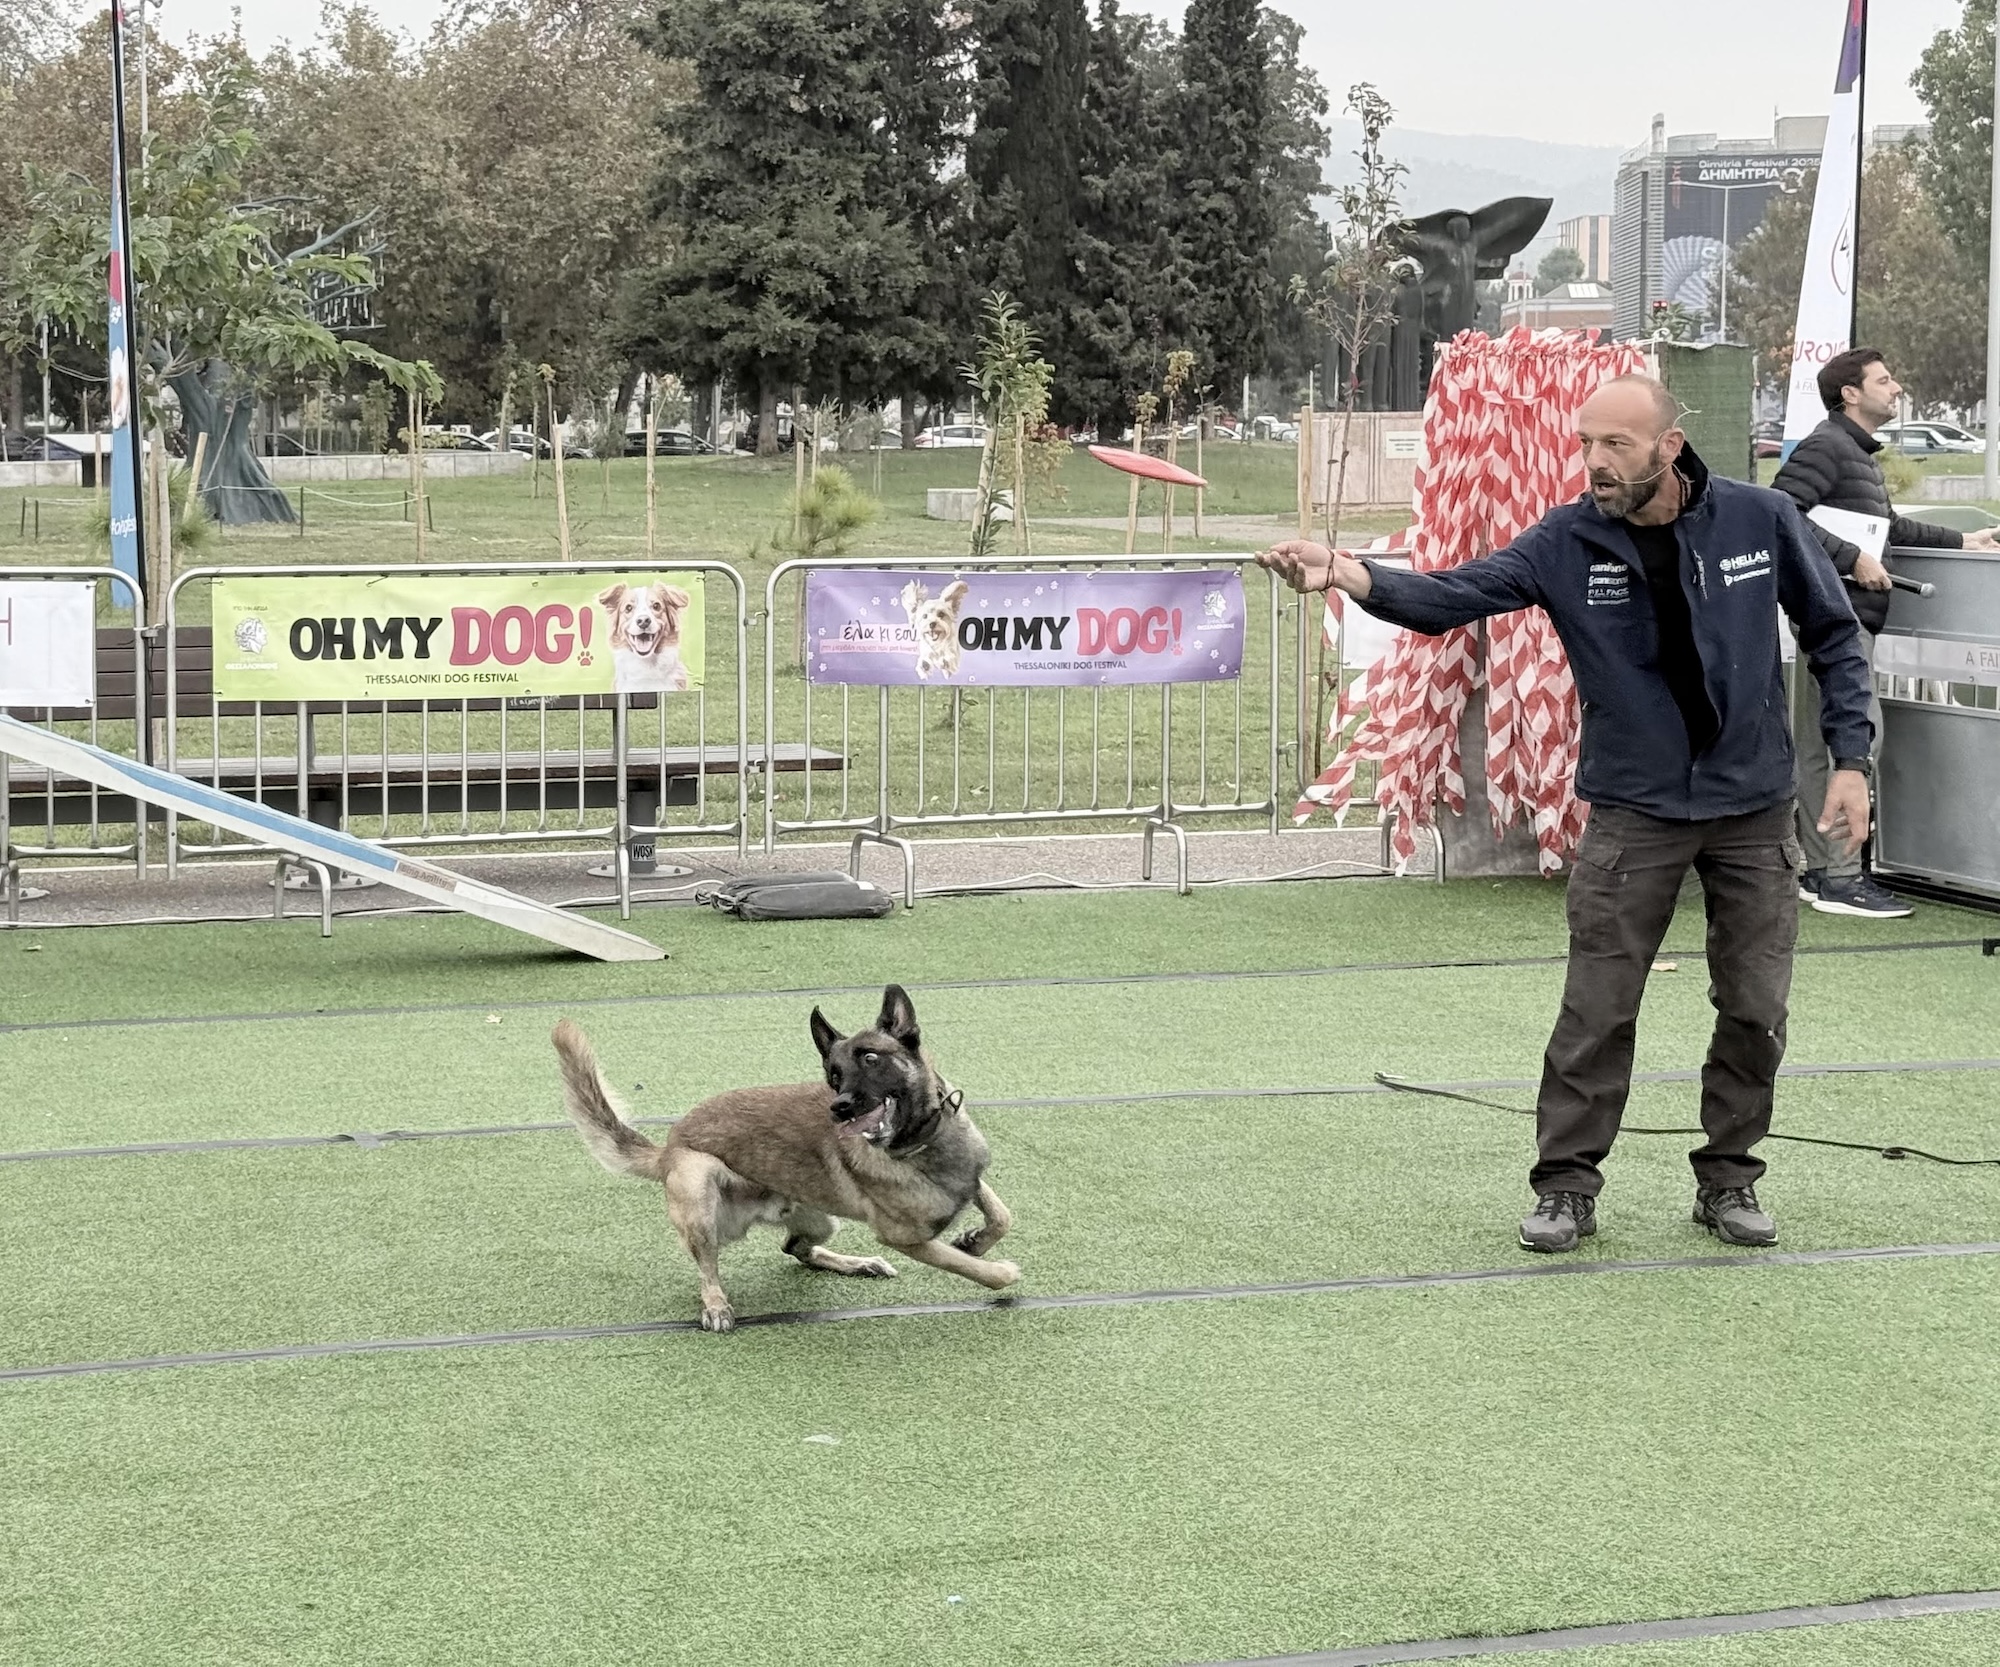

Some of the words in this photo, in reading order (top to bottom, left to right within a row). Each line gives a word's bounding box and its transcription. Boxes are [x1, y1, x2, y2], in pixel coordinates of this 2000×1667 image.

[1699, 159, 1742, 168] Dimitria
[1745, 158, 1788, 167] Festival
[1698, 168, 1780, 181] ΔΗΜΗΤΡΙΑ
[1731, 549, 1770, 570] HELLAS
[290, 617, 356, 661] OH
[363, 617, 443, 659] MY
[450, 604, 594, 666] DOG!
[958, 616, 1008, 651] OH
[1011, 616, 1071, 651] MY
[1076, 606, 1184, 657] DOG!
[1965, 650, 1975, 666] A
[1014, 661, 1071, 671] THESSALONIKI
[1073, 661, 1093, 670] DOG
[1094, 660, 1128, 670] FESTIVAL
[365, 674, 441, 685] THESSALONIKI
[445, 673, 471, 684] DOG
[474, 672, 519, 683] FESTIVAL
